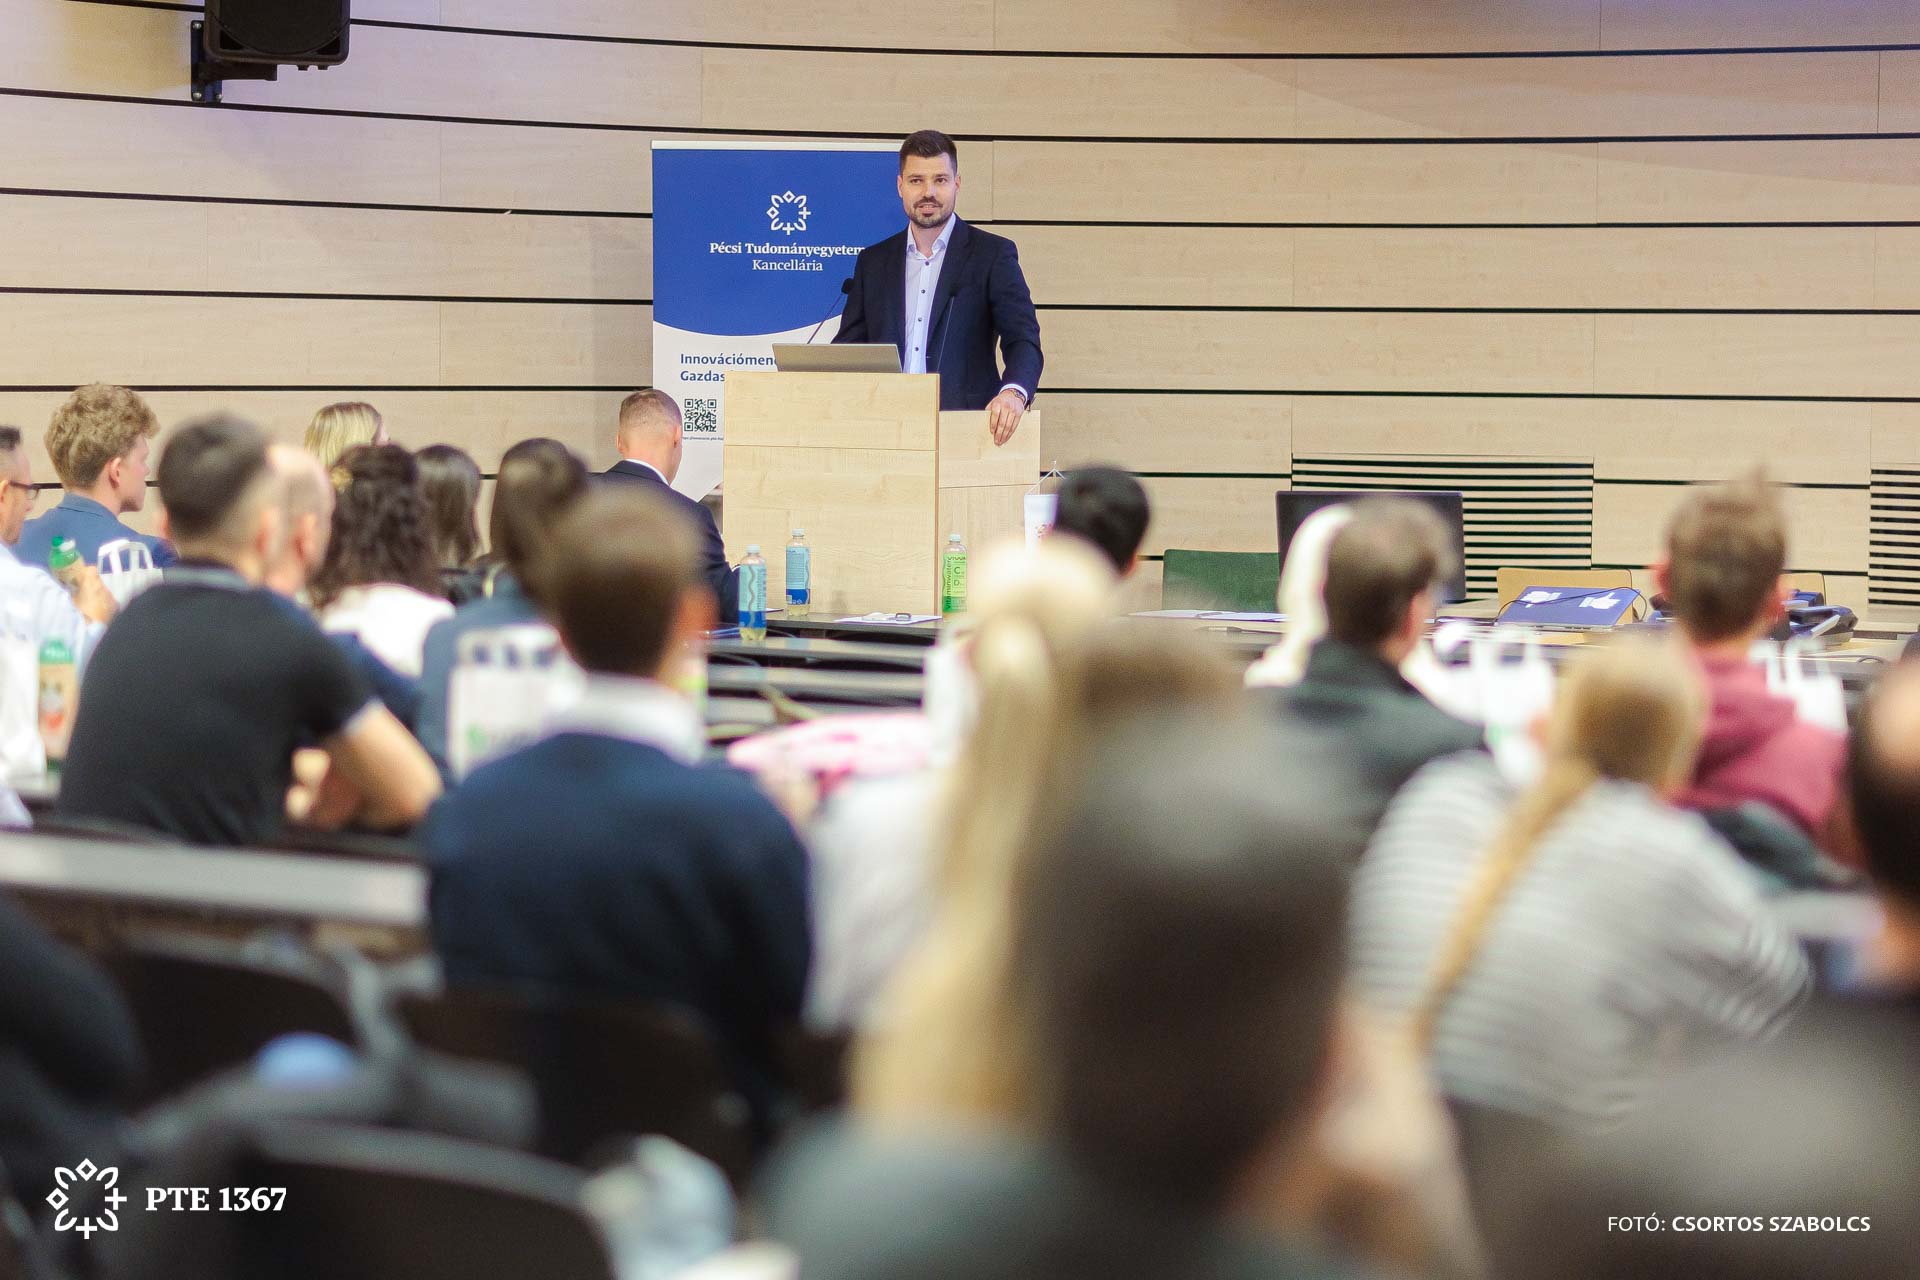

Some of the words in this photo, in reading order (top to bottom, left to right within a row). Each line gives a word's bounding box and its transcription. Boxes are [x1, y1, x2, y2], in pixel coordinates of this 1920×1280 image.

[709, 242, 742, 254] Pécsi
[752, 259, 824, 272] Kancellária
[680, 352, 777, 366] Innovációmen
[680, 370, 725, 382] Gazdas
